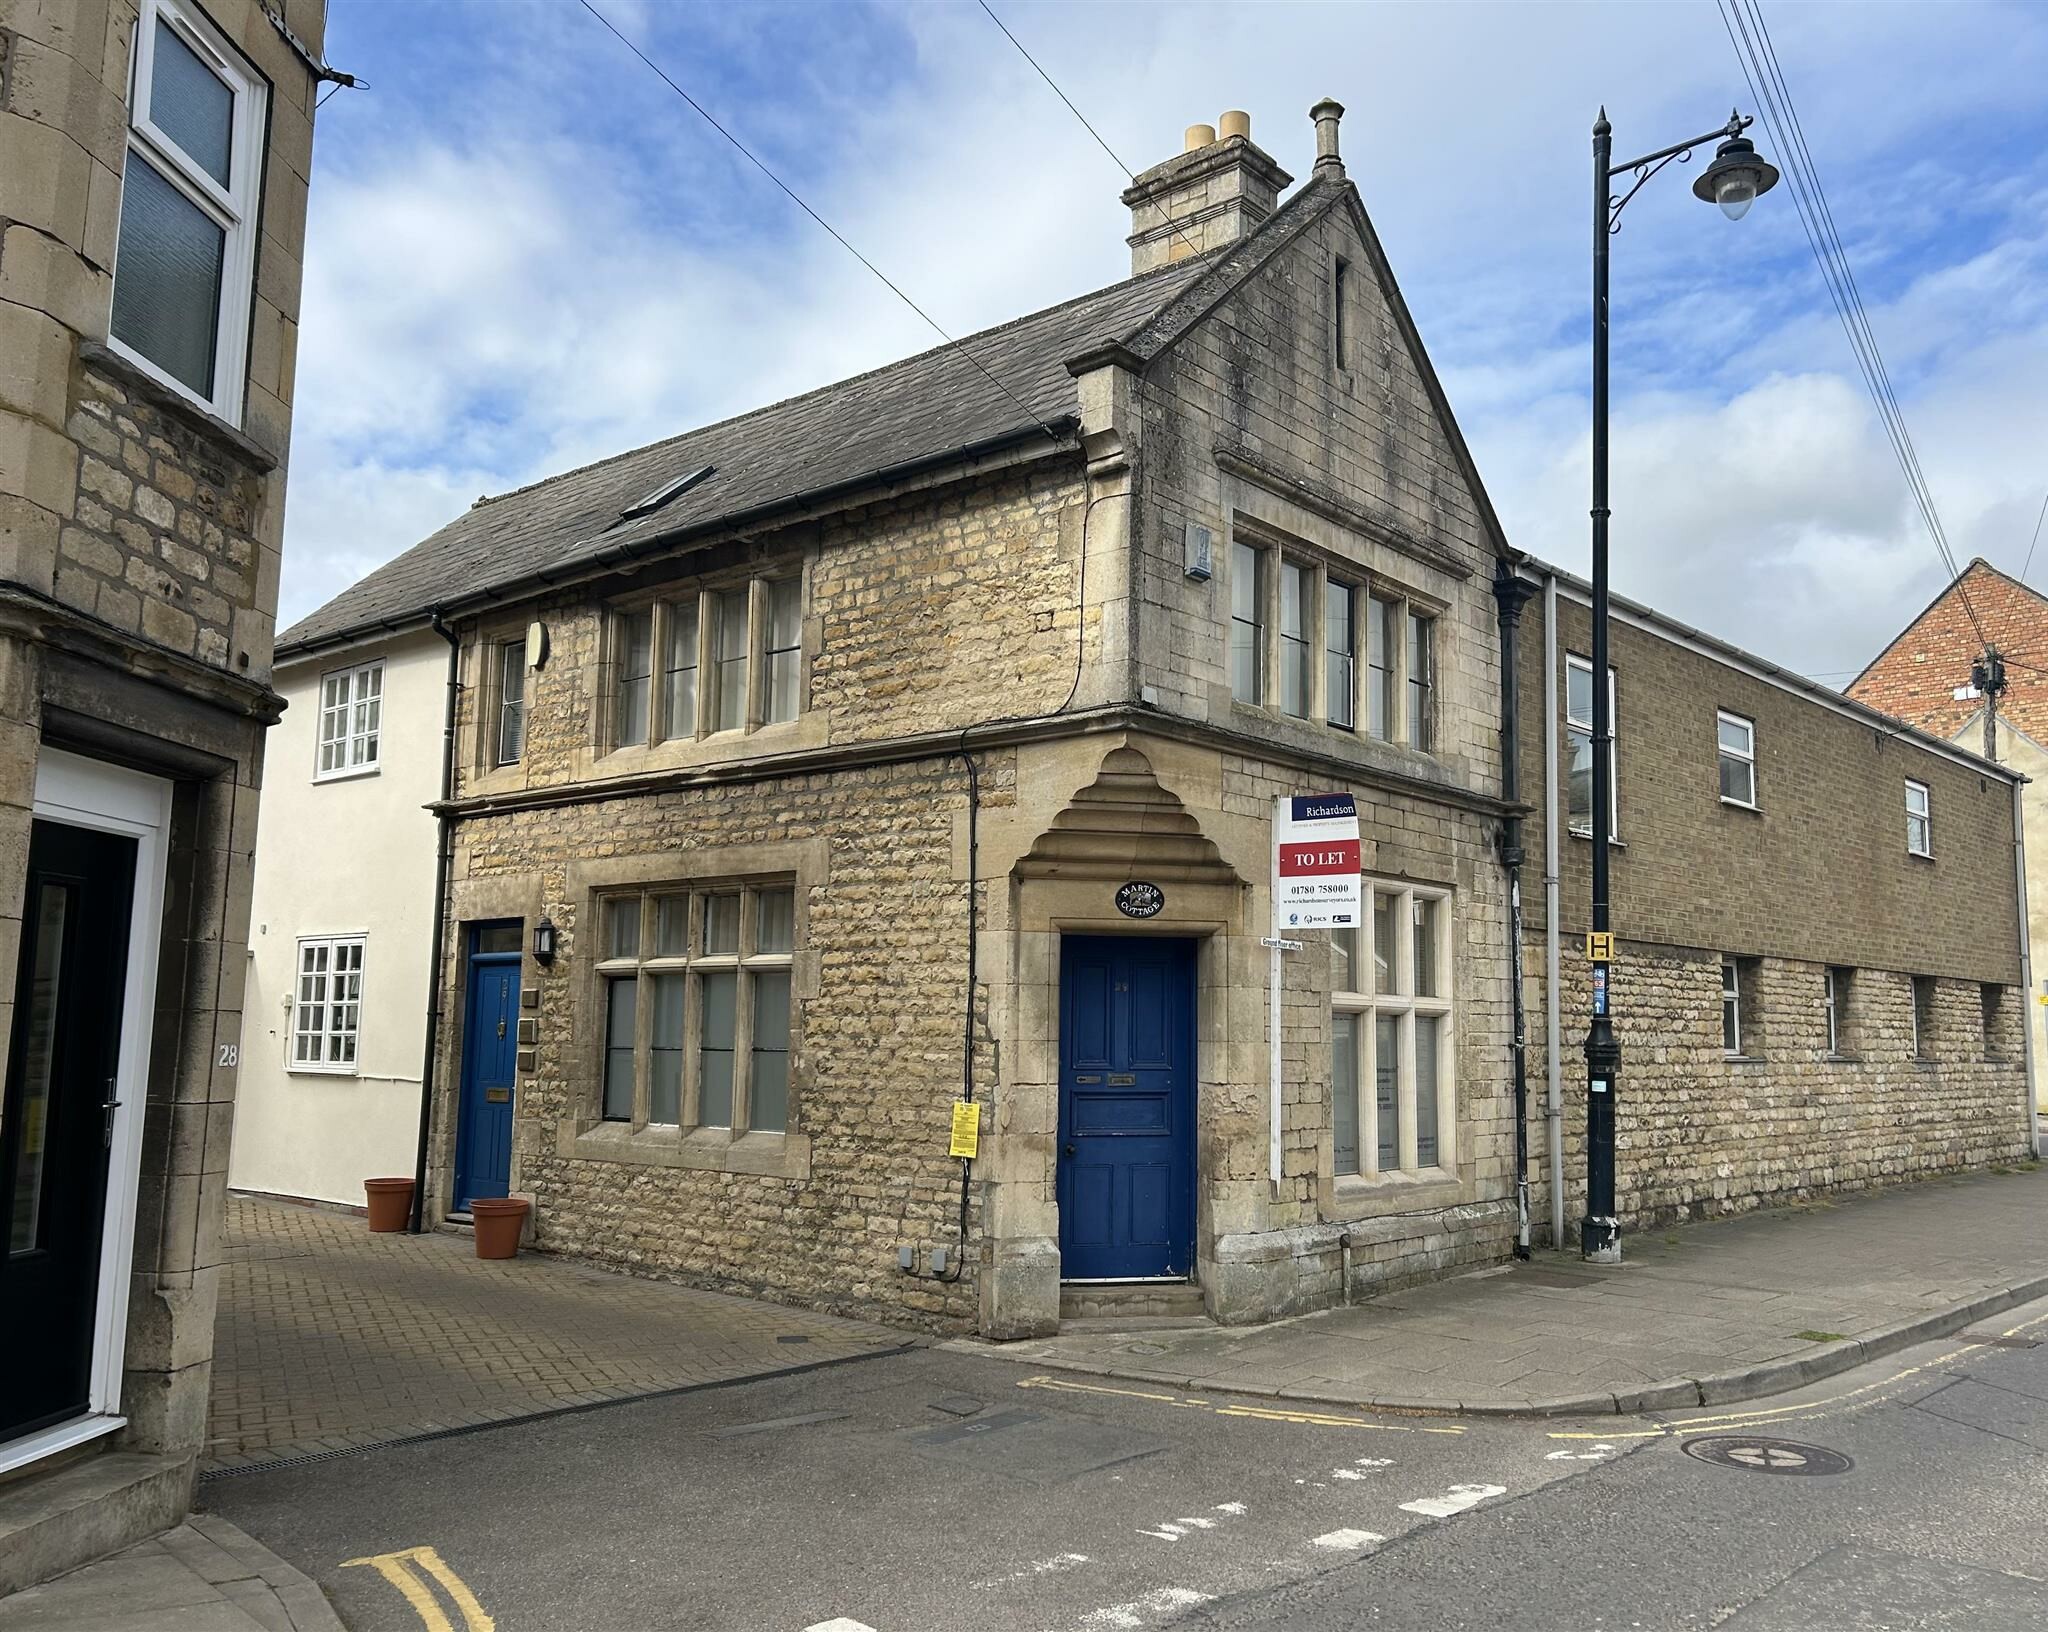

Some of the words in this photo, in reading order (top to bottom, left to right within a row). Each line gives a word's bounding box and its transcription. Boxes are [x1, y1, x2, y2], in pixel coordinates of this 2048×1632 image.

[1306, 804, 1354, 817] Richardson
[1294, 853, 1314, 866] TO
[1318, 851, 1345, 865] LET
[1121, 884, 1160, 897] MARTIN
[1291, 886, 1315, 895] 01780
[1318, 884, 1349, 894] 758000
[1121, 901, 1160, 915] COTTAGE
[1591, 936, 1609, 957] H
[219, 1044, 237, 1067] 28
